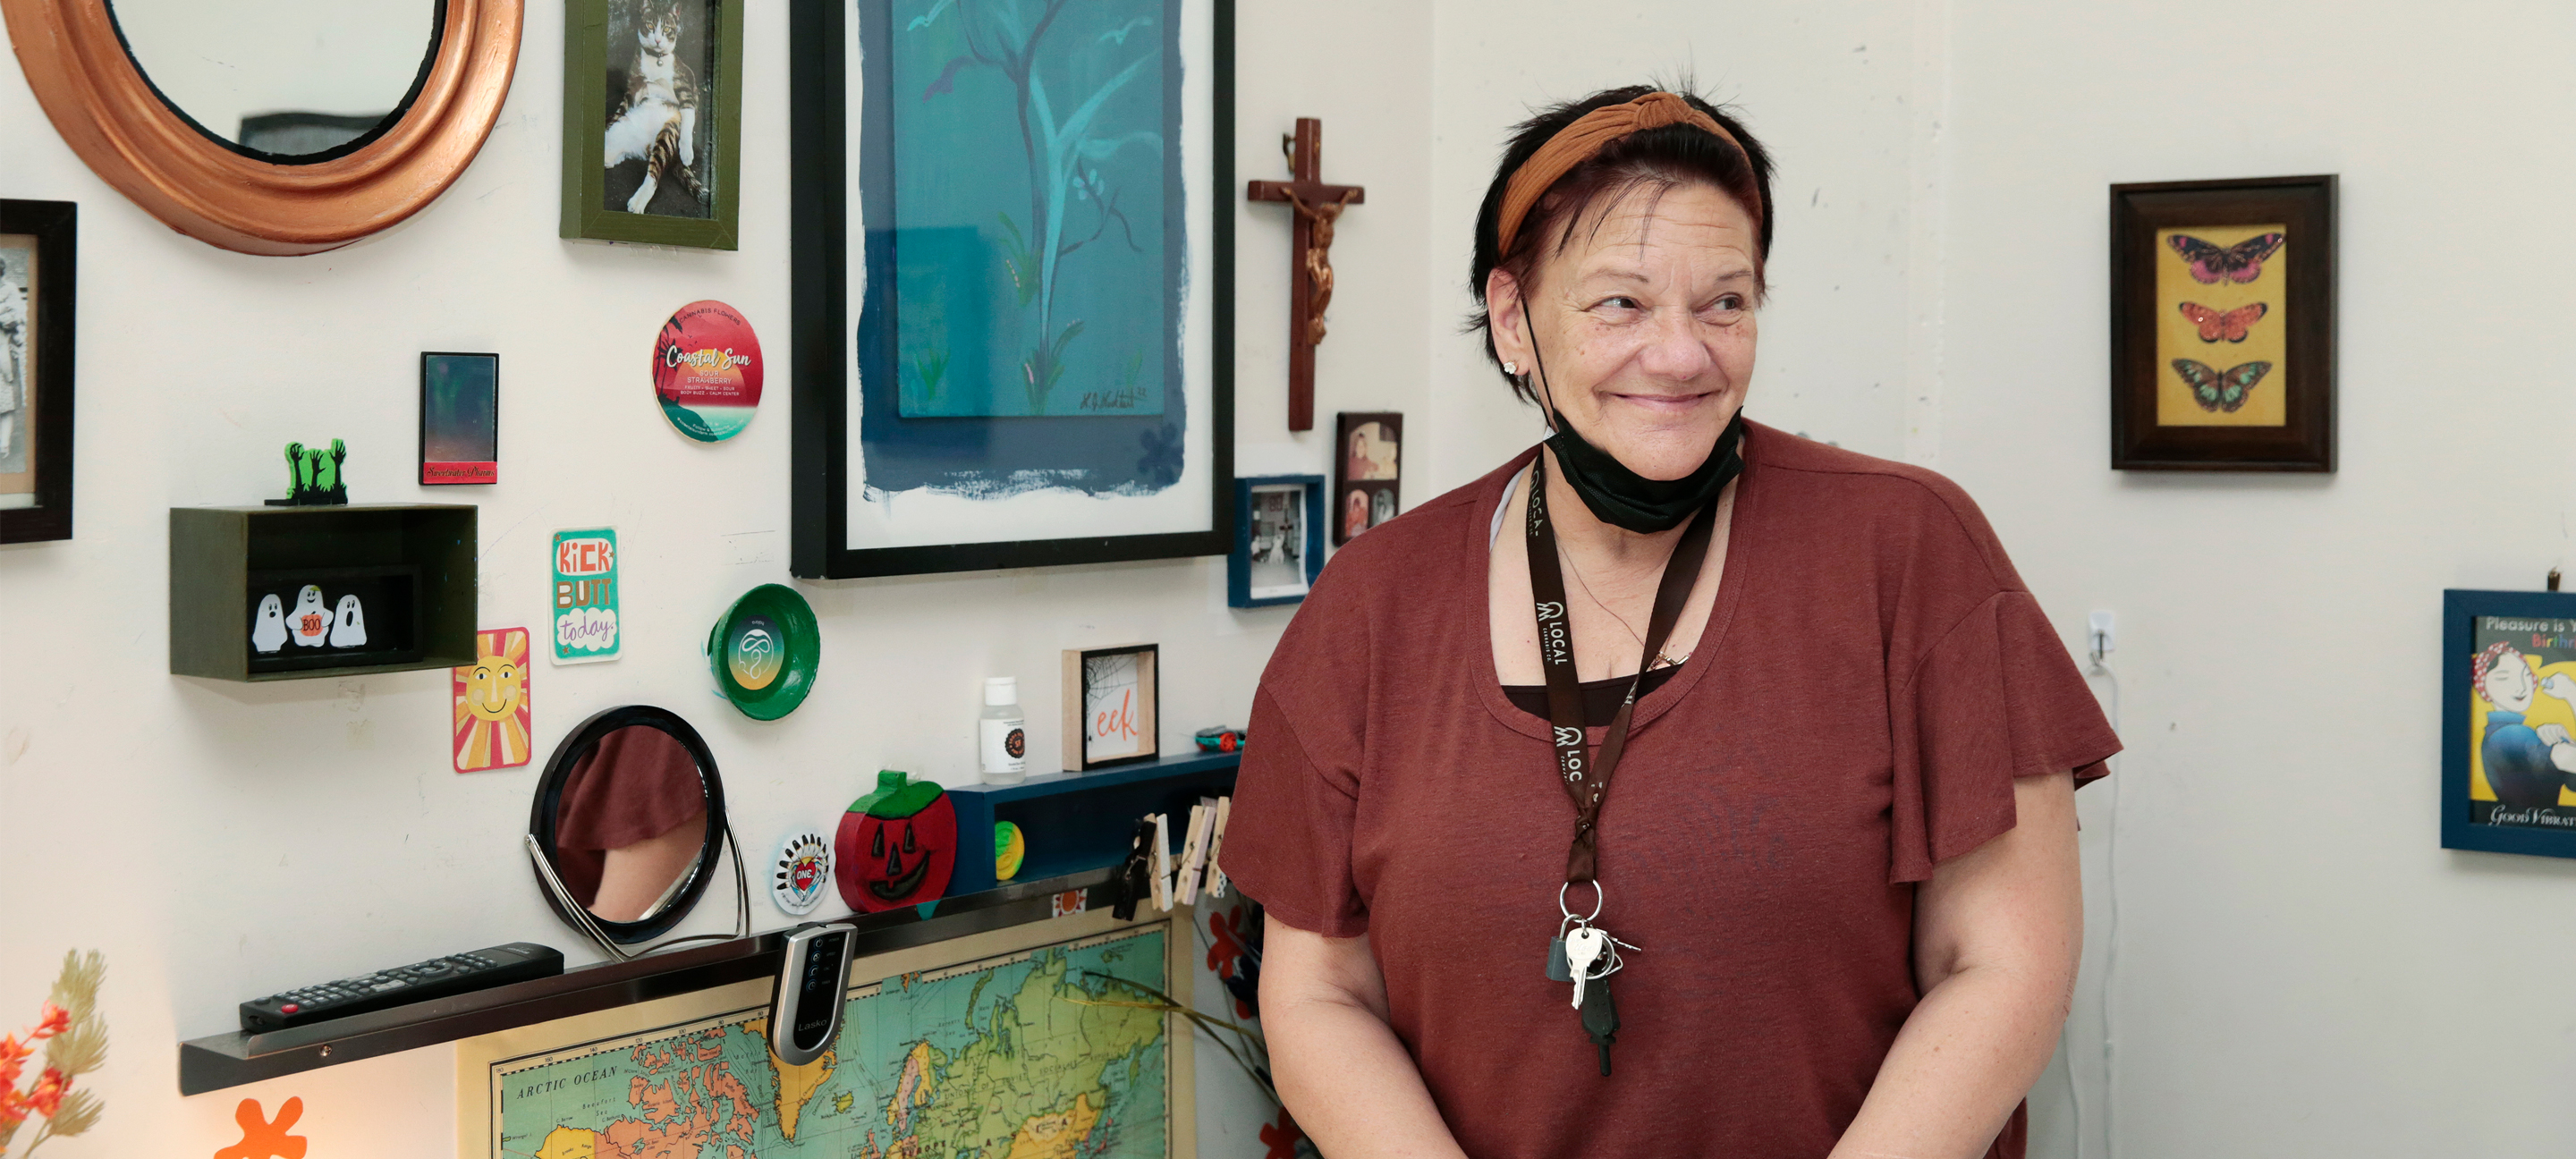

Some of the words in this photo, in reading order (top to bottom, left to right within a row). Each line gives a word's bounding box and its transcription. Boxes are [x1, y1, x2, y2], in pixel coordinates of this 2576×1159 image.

[679, 308, 712, 324] CANNABIS
[713, 308, 741, 326] FLOWERS
[665, 344, 721, 368] Coastal
[721, 347, 752, 371] Sun
[687, 376, 733, 385] STRAWBERRY
[556, 579, 612, 609] BUTT
[302, 618, 321, 631] BOO
[2486, 615, 2549, 632] Pleasure
[2553, 618, 2565, 632] is
[1542, 627, 1551, 653] CANNABIS
[1549, 622, 1568, 665] LOCAL
[1097, 688, 1138, 741] eek
[798, 1019, 827, 1032] Lasko
[516, 1078, 566, 1099] ARCTIC
[573, 1065, 618, 1086] OCEAN
[582, 1096, 616, 1109] Beaufort
